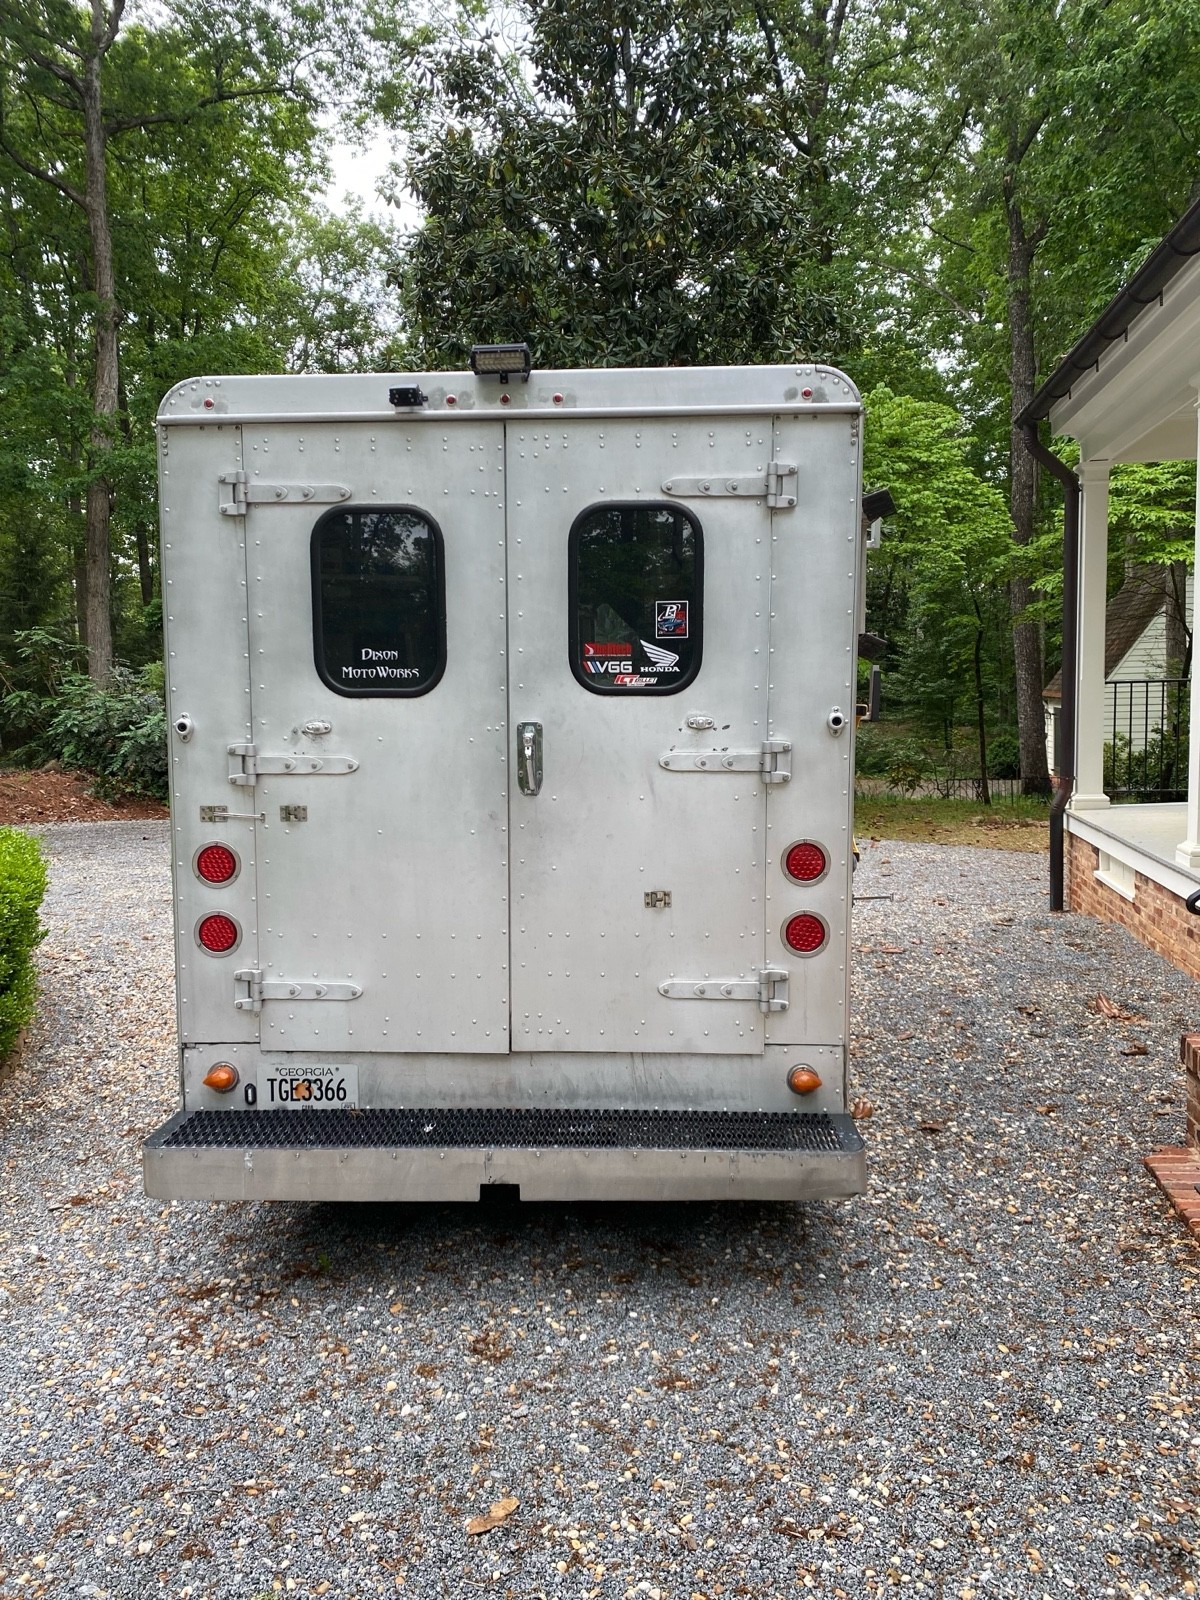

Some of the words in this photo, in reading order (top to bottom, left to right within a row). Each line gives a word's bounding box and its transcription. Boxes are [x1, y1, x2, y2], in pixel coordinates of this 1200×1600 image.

[596, 661, 632, 673] VGG
[278, 1067, 334, 1077] GEORGIA
[266, 1078, 347, 1102] TGE3366
